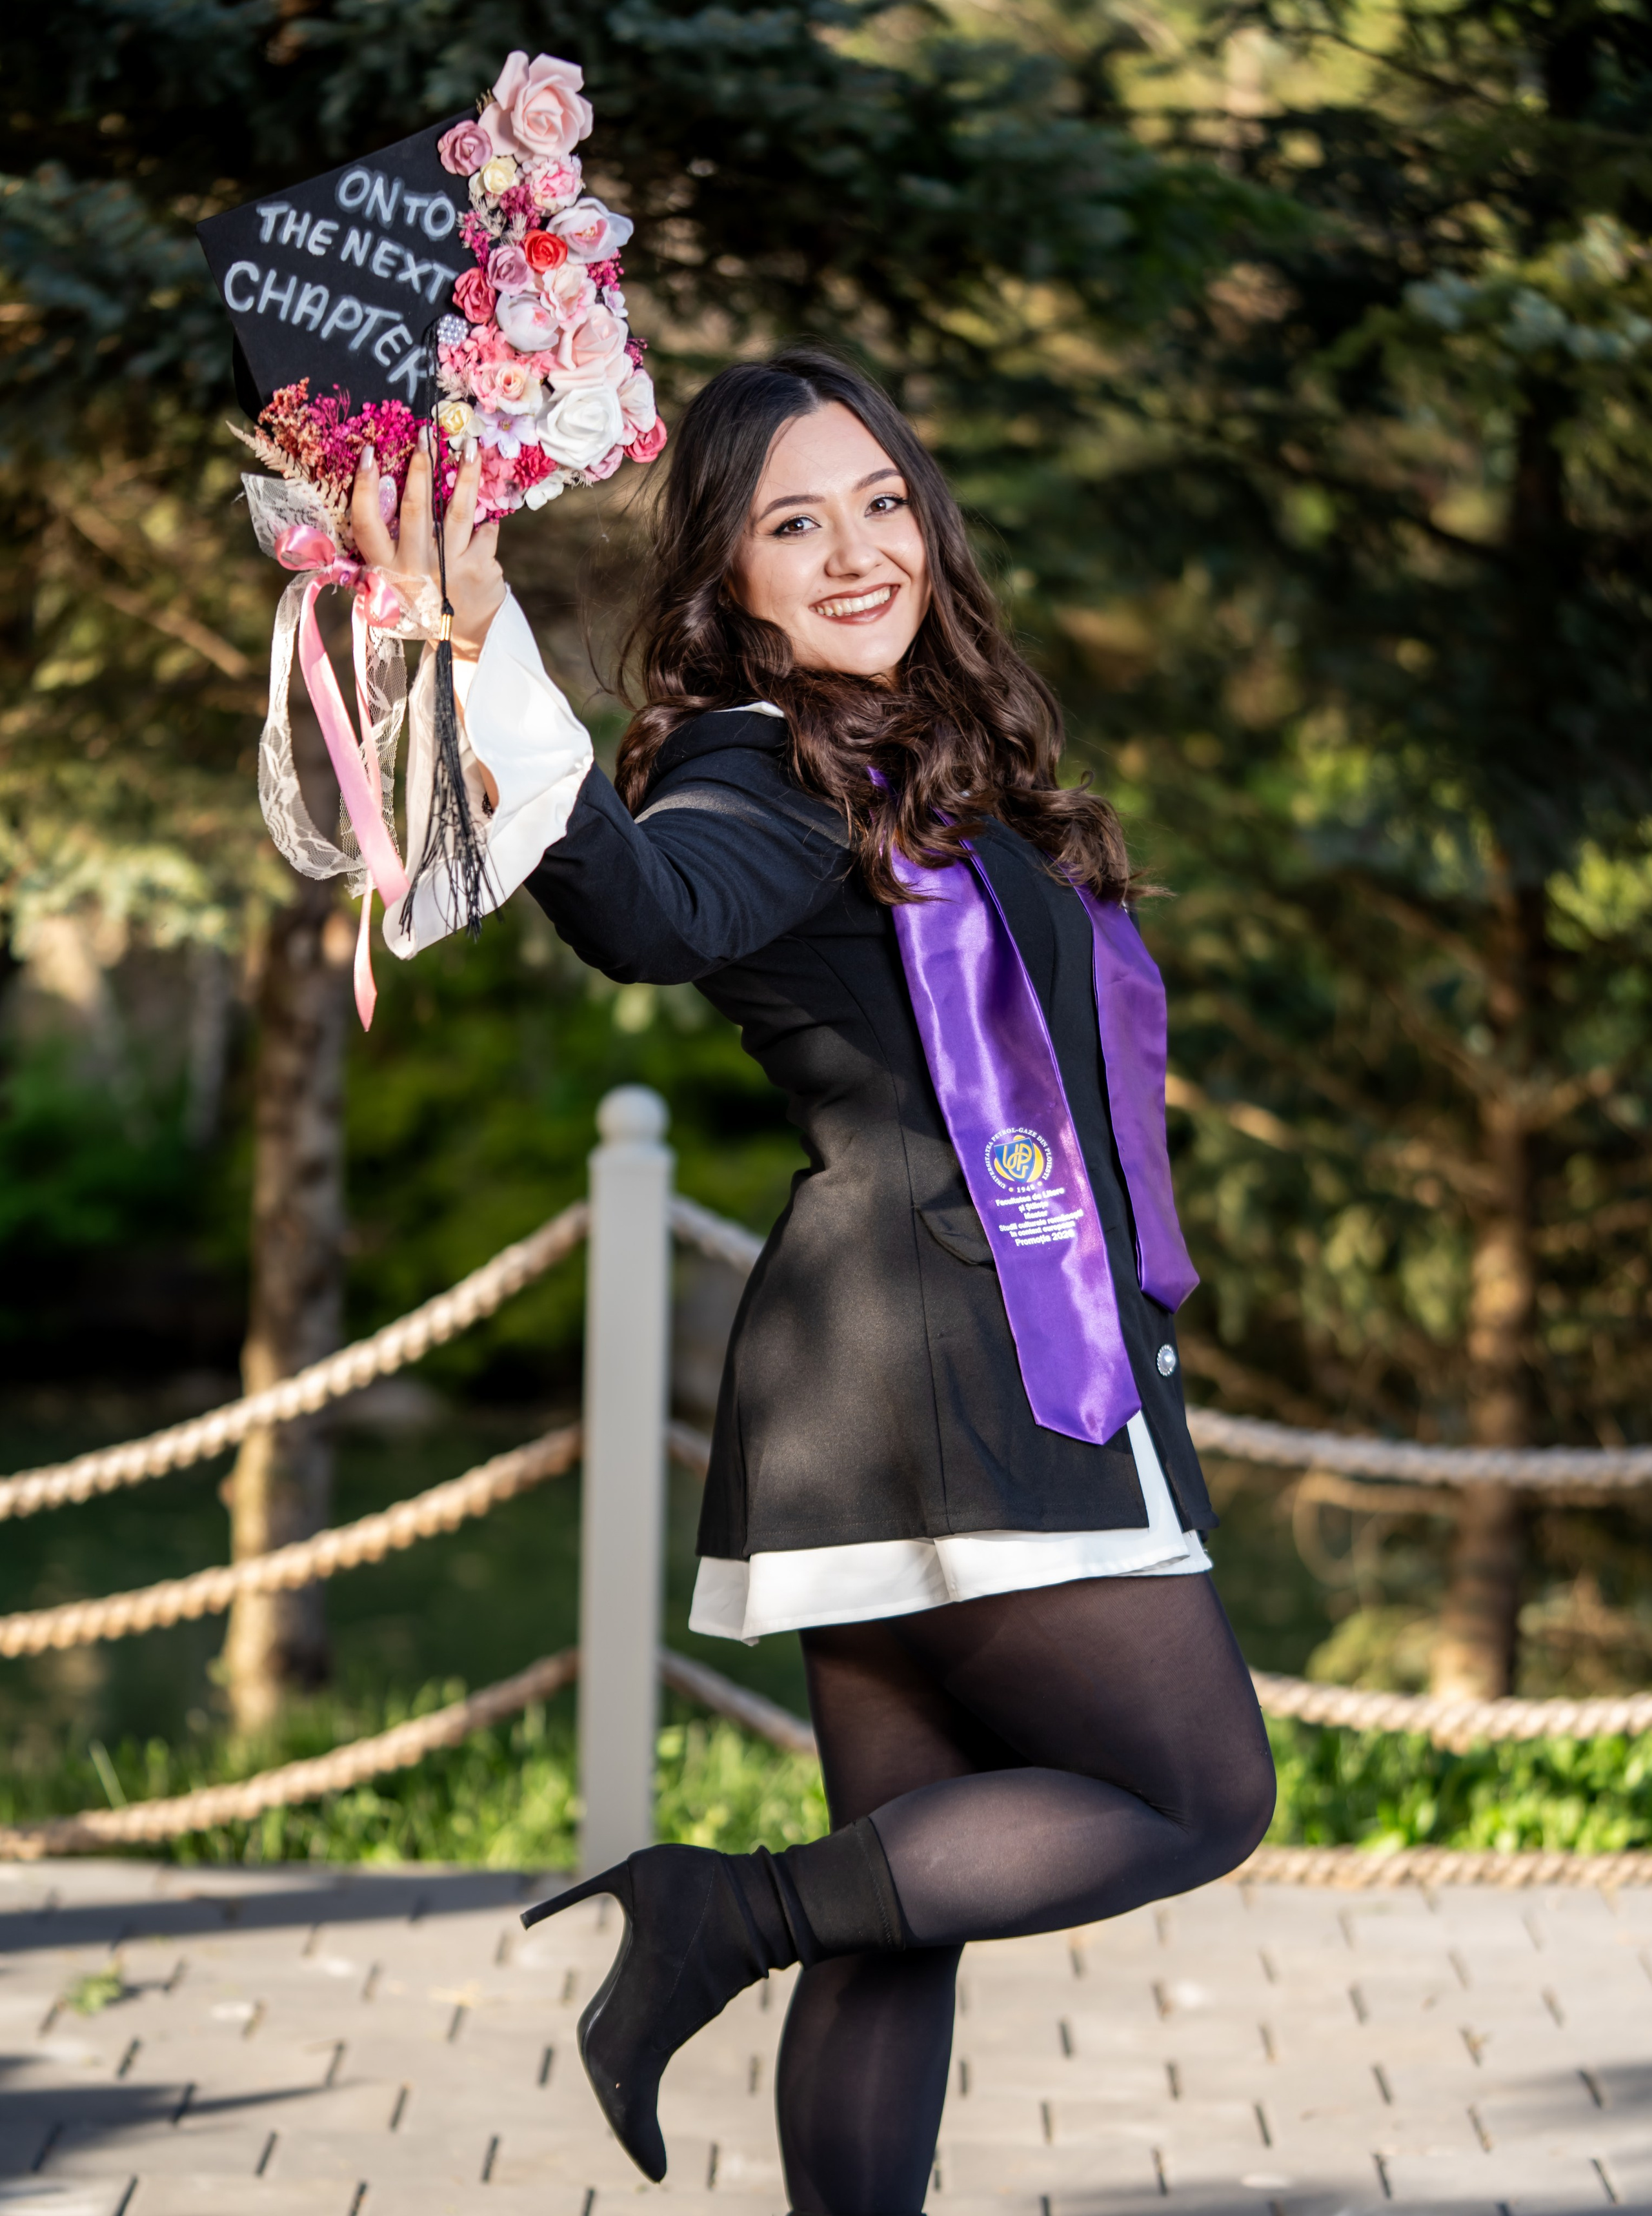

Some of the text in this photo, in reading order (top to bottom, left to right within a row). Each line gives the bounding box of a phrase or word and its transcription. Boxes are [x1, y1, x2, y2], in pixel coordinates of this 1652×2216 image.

[256, 202, 458, 303] THE NEXT
[224, 260, 436, 403] CHAPTER
[985, 1142, 1006, 1189] UNIVERSITATEA
[1036, 1135, 1048, 1148] DIN
[1016, 1184, 1035, 1193] 1948
